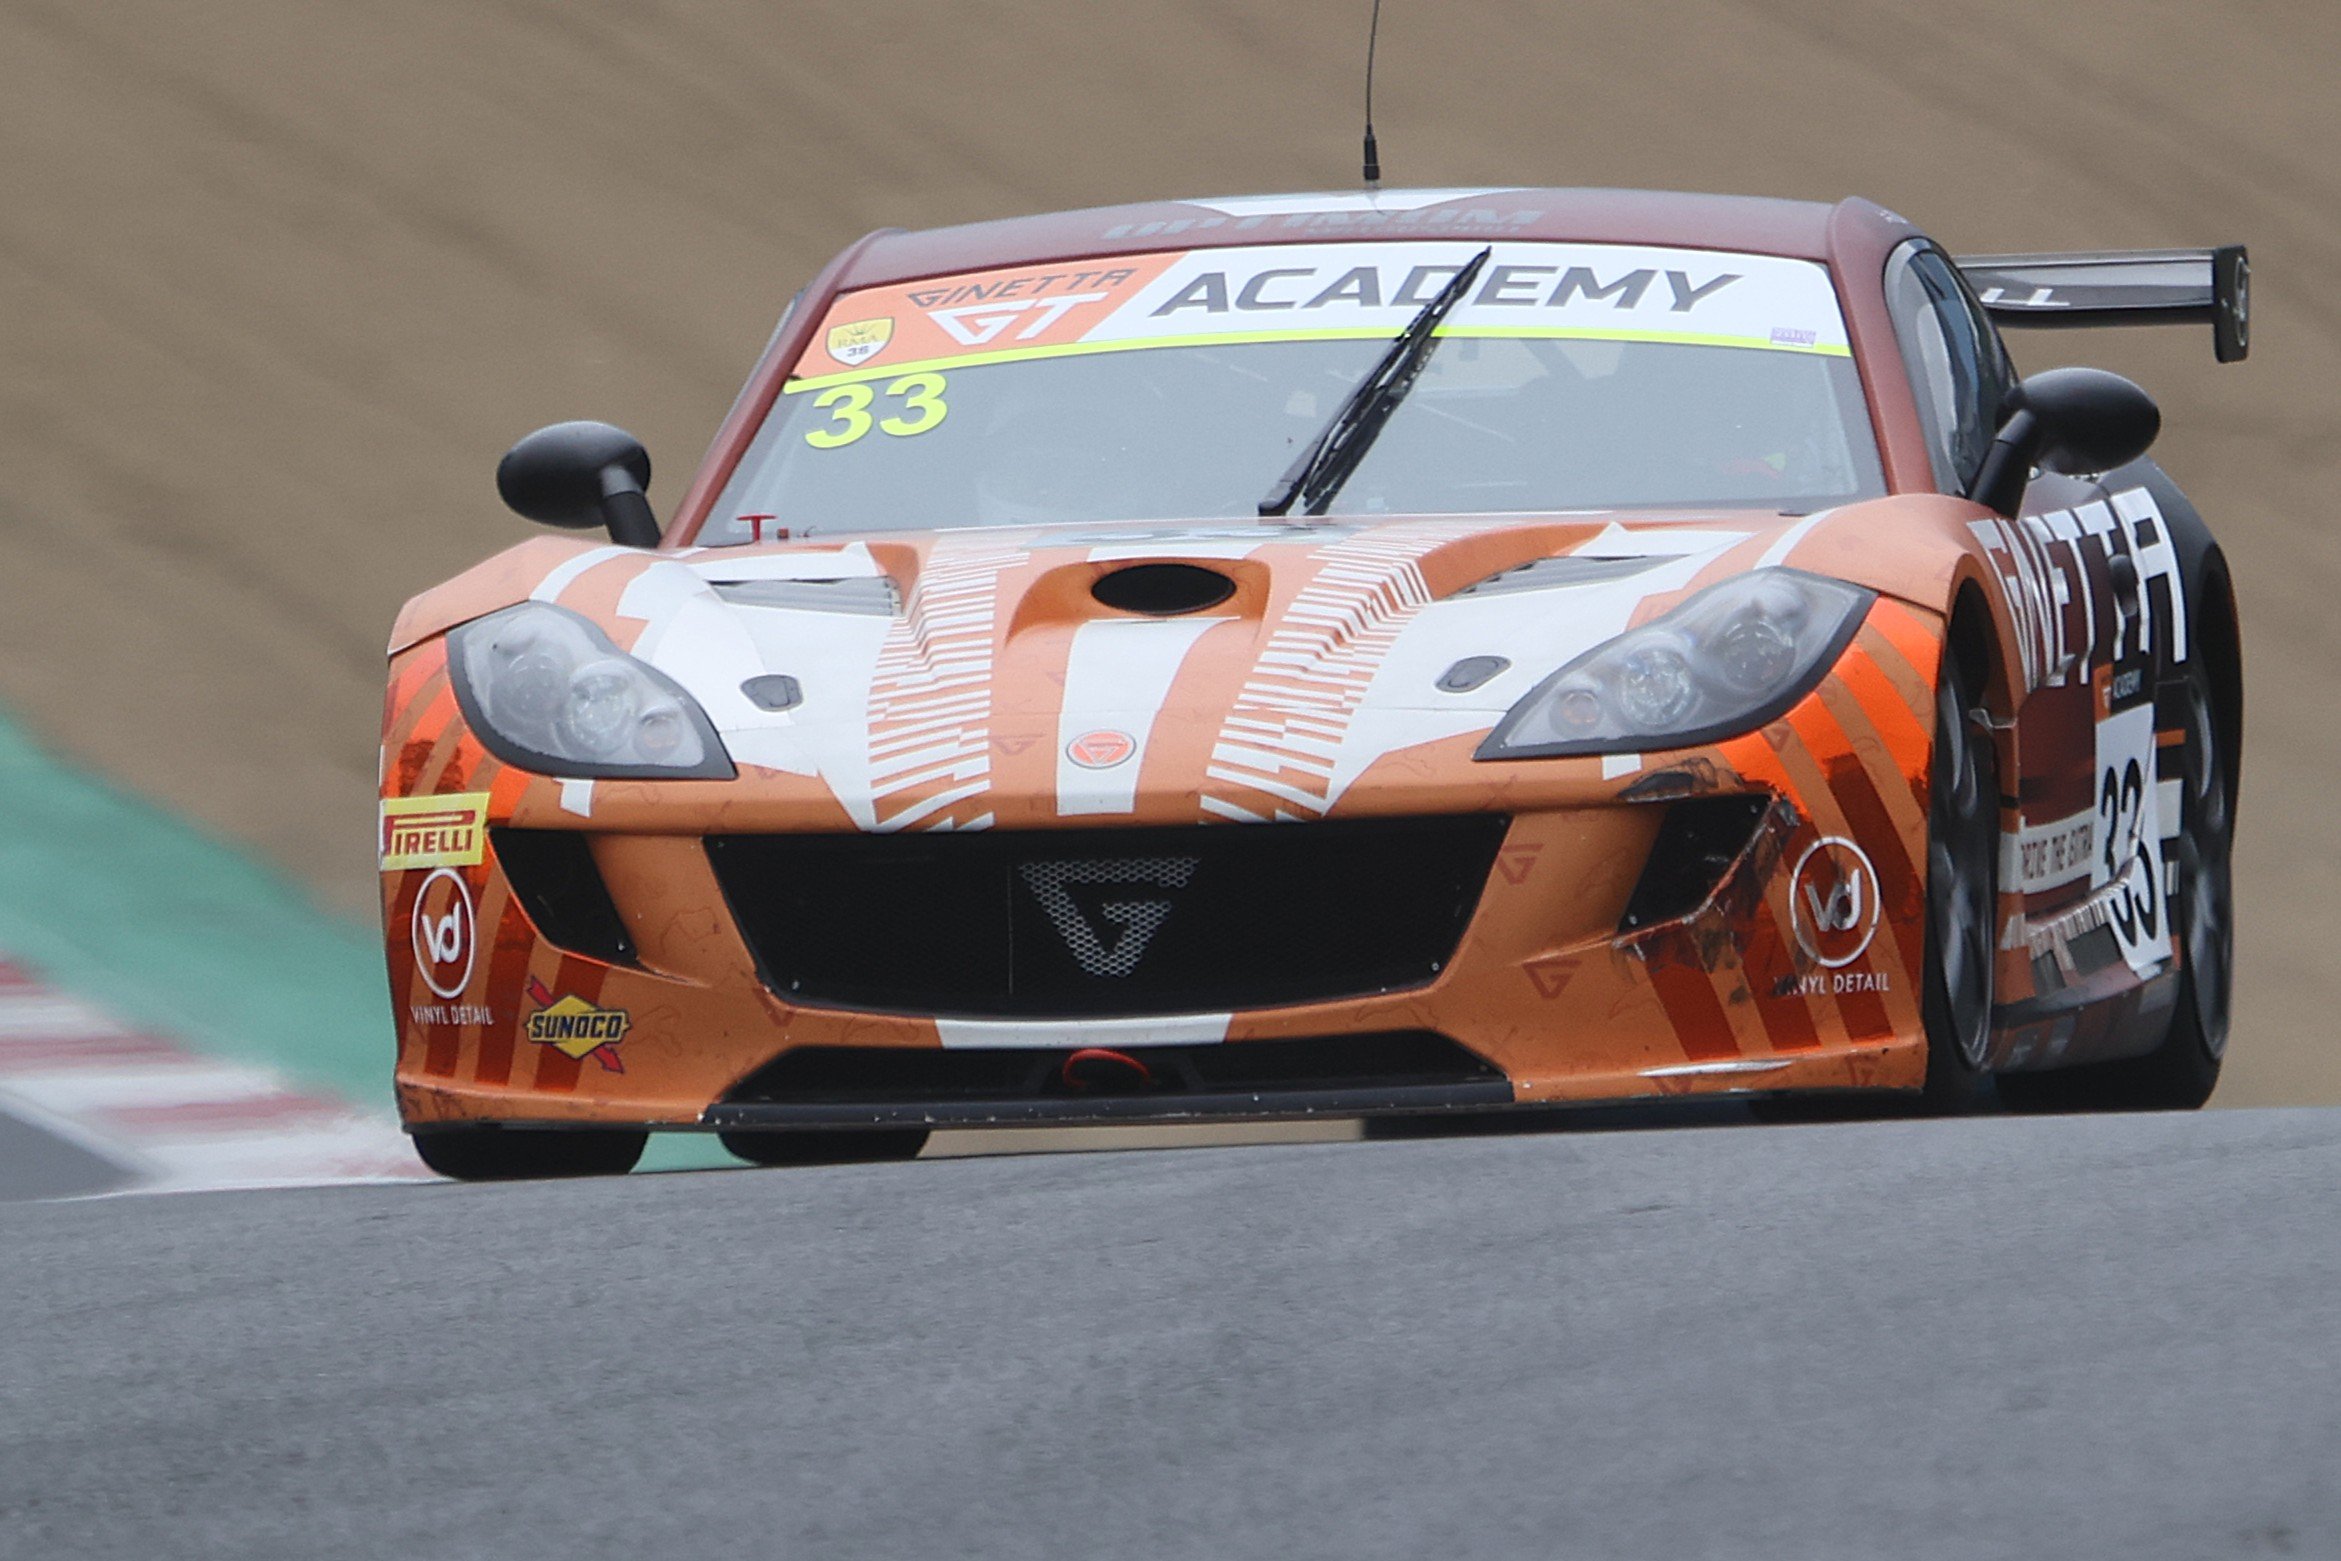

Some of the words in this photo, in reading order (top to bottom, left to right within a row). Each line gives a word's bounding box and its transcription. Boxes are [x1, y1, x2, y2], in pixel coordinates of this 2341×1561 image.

[907, 268, 1137, 308] GINETTA
[1149, 264, 1743, 318] ACADEMY
[926, 292, 1110, 347] GT
[804, 371, 948, 451] 33
[384, 809, 476, 857] PIRELLI
[1832, 972, 1890, 994] DETAIL
[410, 1004, 447, 1027] VINYL
[449, 1005, 495, 1026] DETAIL
[530, 1014, 623, 1040] SUNOCO
